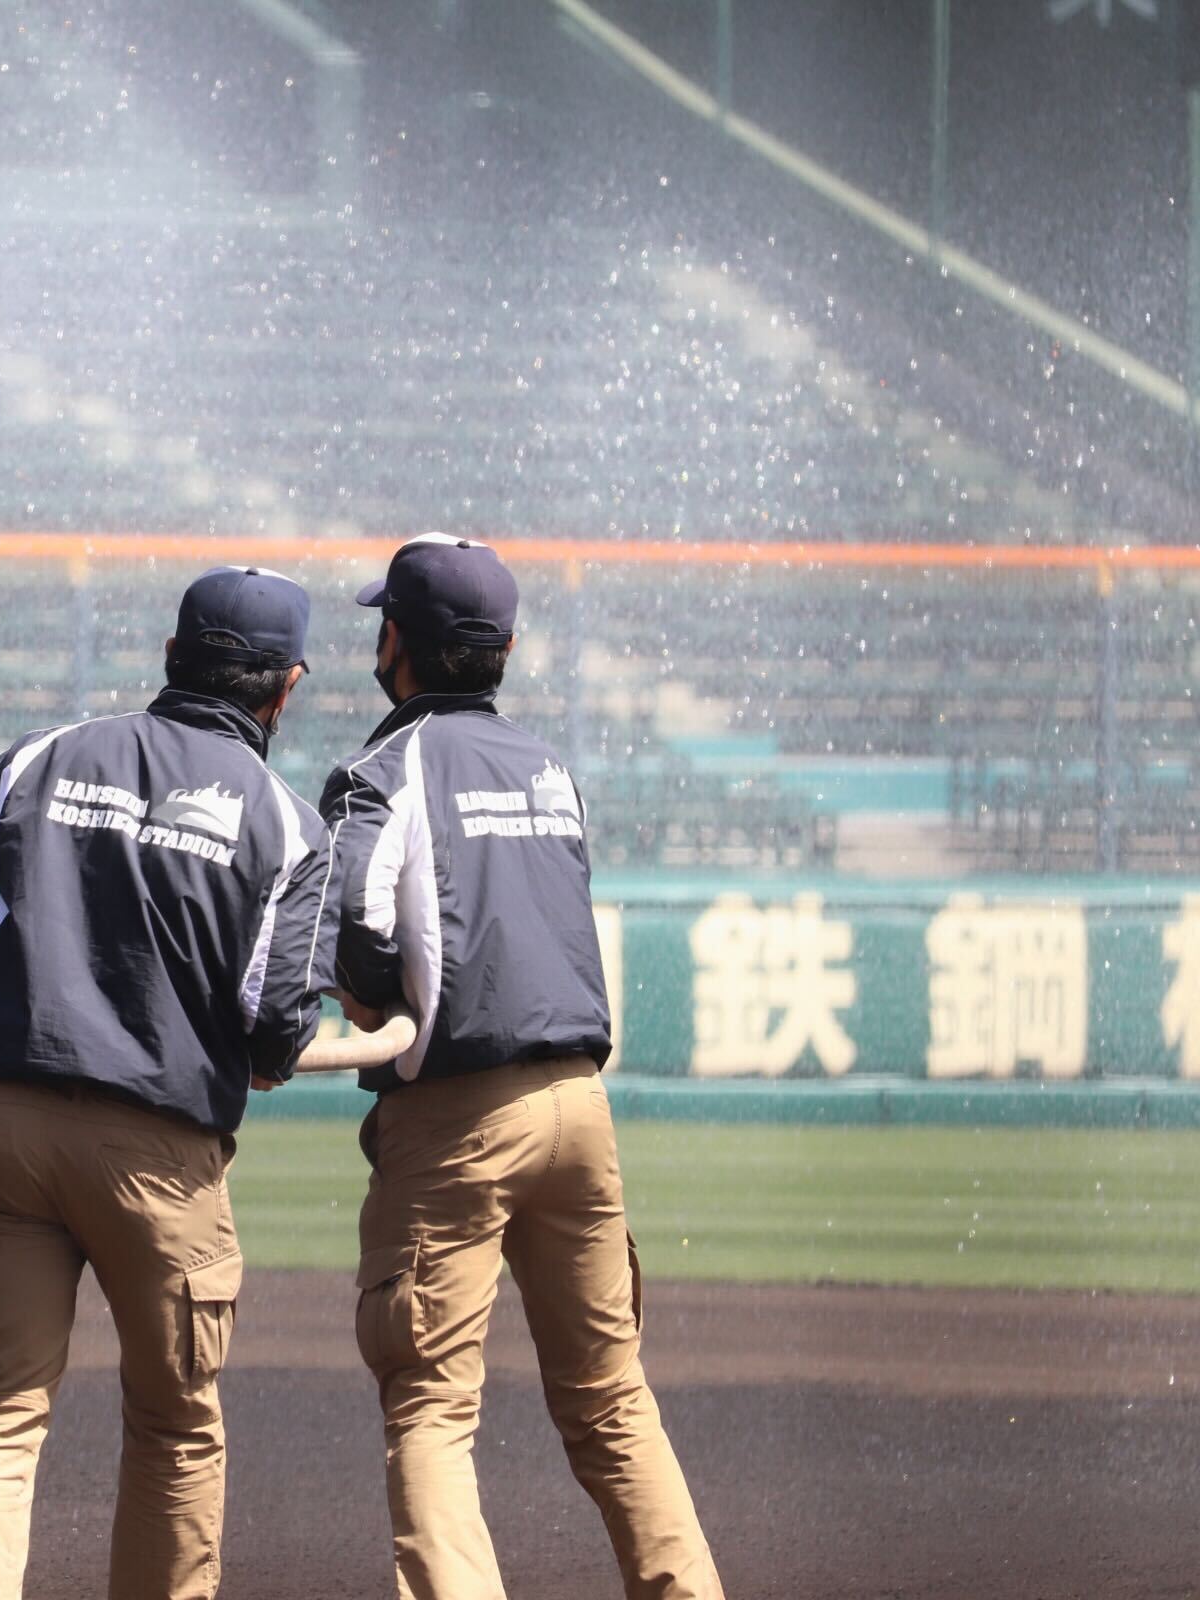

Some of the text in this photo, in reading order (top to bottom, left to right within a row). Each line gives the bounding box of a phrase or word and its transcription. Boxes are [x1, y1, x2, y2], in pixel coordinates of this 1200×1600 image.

[47, 800, 236, 867] KOSHIEN STADIUM
[596, 891, 1200, 1078] 鉄鋼
